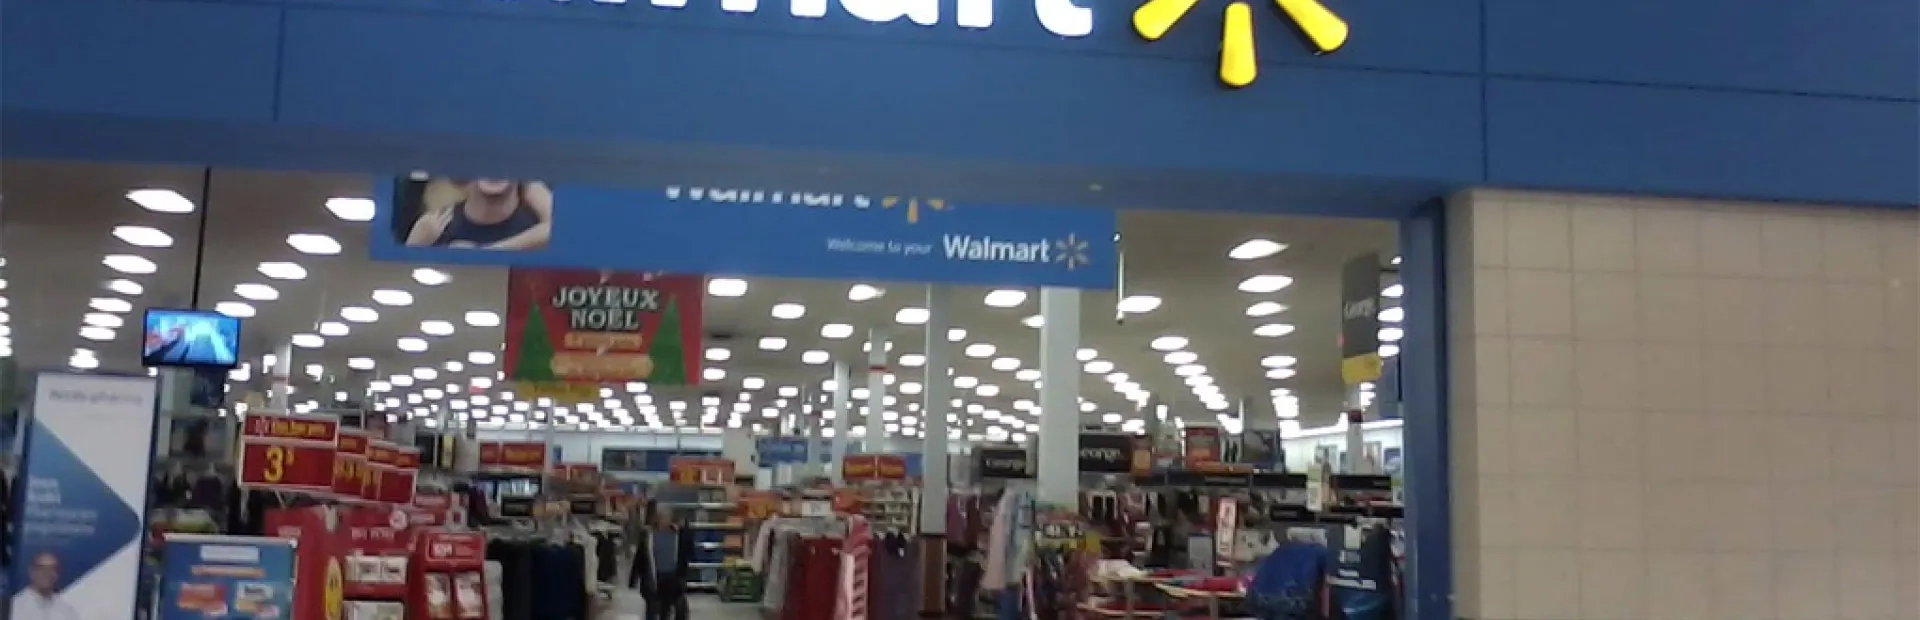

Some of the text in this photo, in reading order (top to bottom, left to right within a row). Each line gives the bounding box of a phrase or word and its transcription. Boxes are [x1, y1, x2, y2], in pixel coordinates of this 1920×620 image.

[827, 234, 1050, 262] Welcome to your Walmart
[552, 286, 660, 309] JOYEUX
